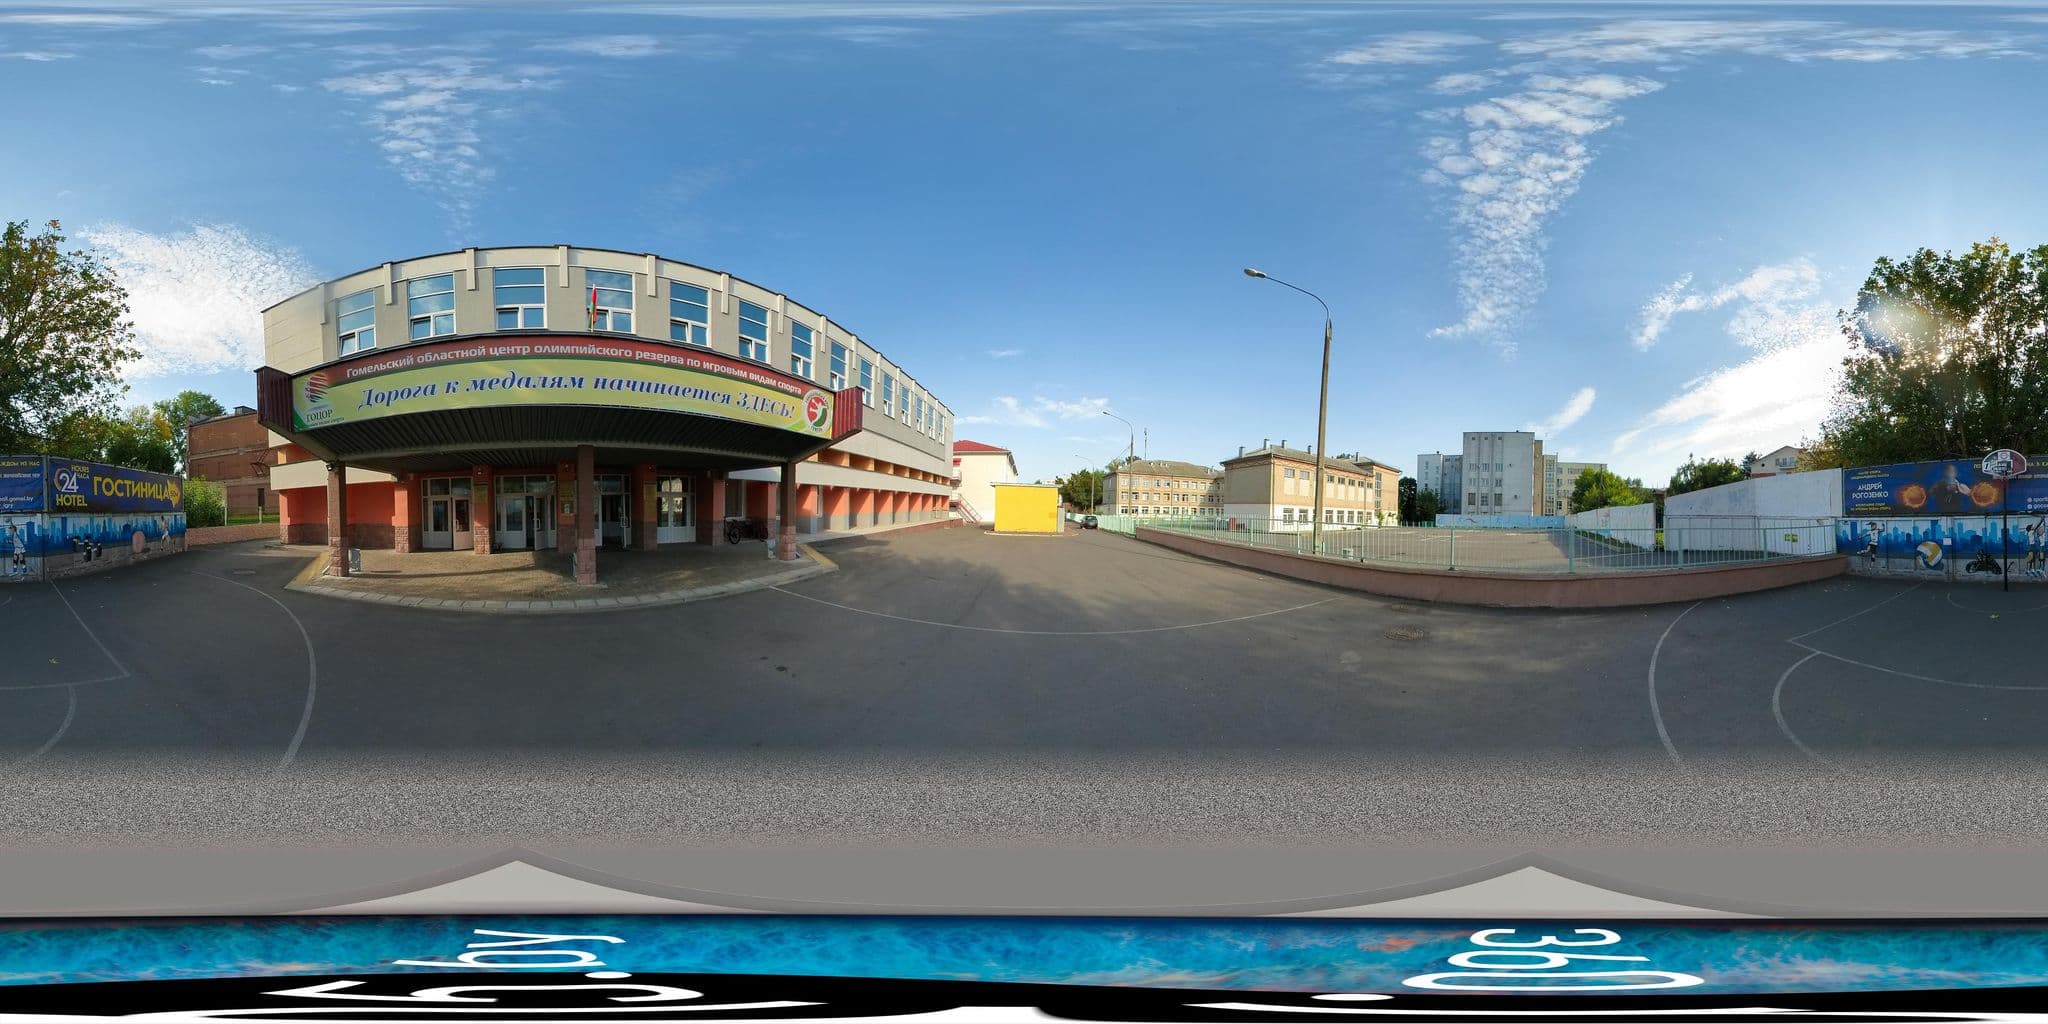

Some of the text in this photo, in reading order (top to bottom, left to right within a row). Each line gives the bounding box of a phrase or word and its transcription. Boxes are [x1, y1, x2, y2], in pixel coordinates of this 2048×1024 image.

[346, 343, 802, 396] Гомельский областной центр олимпийского резерва по игровым видам спорта
[358, 382, 437, 411] Дорога
[445, 381, 459, 394] к
[465, 370, 585, 392] медалям
[593, 376, 732, 405] начинается
[735, 391, 796, 419] ЗДЕСЬ!
[306, 408, 334, 423] ГОЦОР
[59, 472, 79, 493] 24
[93, 476, 170, 502] ГОСТИНИЦА
[1857, 481, 1883, 491] АНДРЕЙ
[55, 493, 88, 507] HOTEL
[1852, 491, 1889, 499] РОГОЗЕНКО
